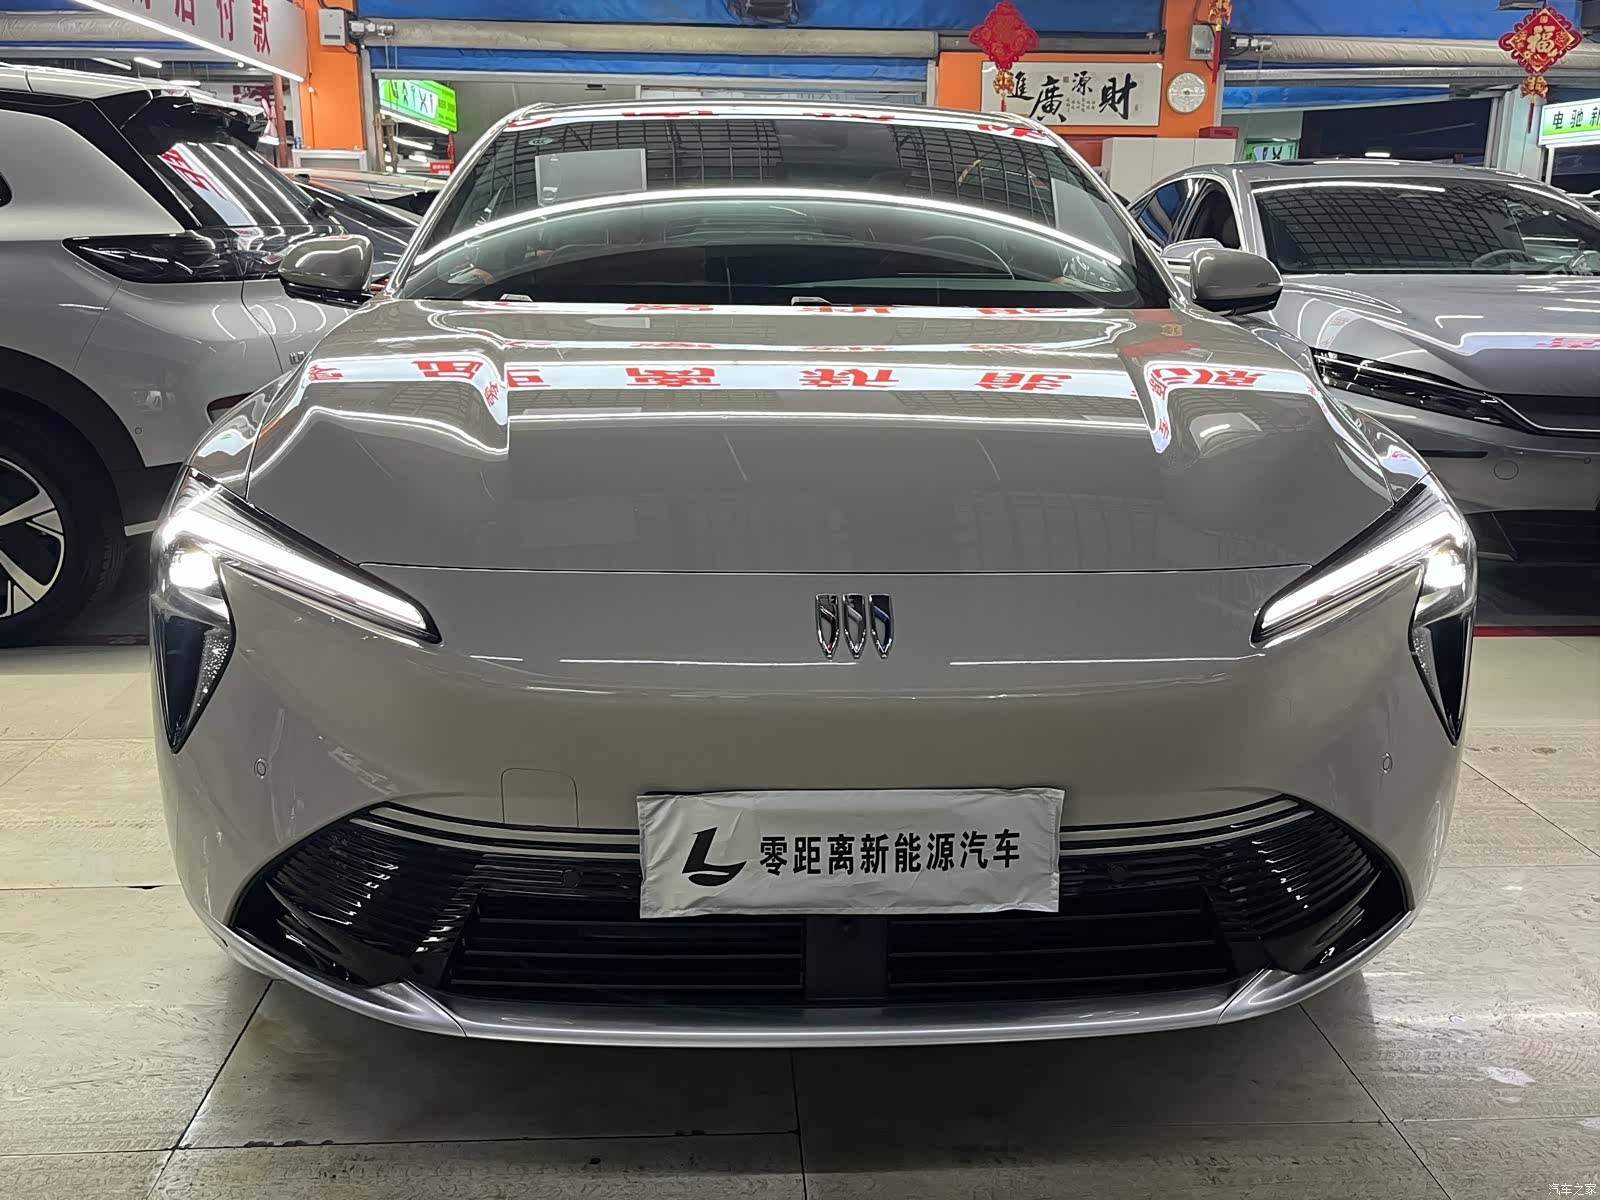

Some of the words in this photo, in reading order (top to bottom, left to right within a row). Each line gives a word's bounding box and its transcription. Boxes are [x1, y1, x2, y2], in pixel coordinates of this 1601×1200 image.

[1527, 25, 1556, 54] 福
[759, 828, 1021, 876] 零距离新能源汽车
